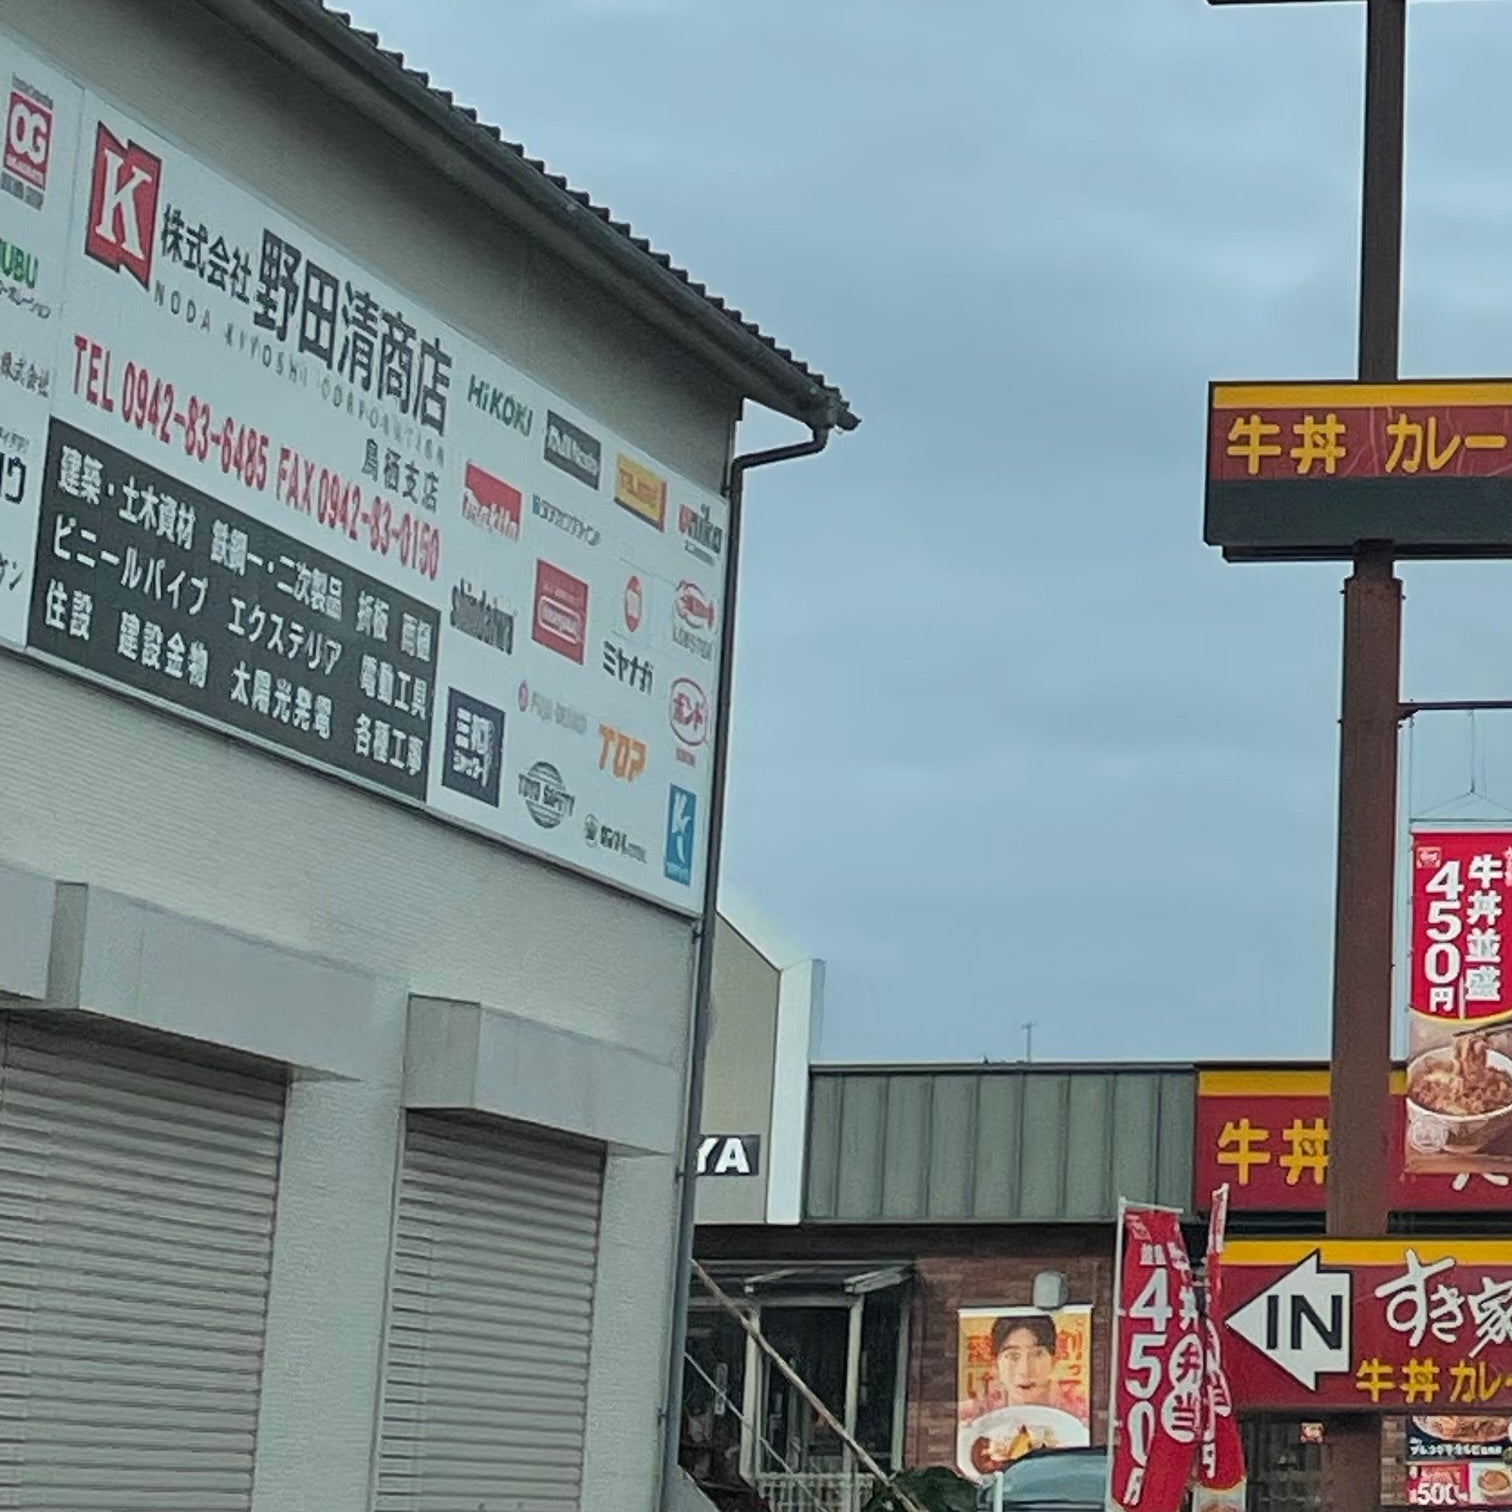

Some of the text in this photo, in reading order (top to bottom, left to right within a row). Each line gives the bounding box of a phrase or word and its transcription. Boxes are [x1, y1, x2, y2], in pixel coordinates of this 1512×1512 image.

[154, 279, 212, 333] NODA
[73, 334, 114, 413] TEL
[121, 360, 270, 492] 0942-83-6485
[275, 446, 316, 514] FAX
[1227, 412, 1508, 475] 牛丼 カレー
[53, 513, 209, 616] ビニールパイプ
[227, 596, 343, 676] エクステリア
[45, 578, 94, 641] 住設
[117, 610, 209, 689] 建設金物
[230, 660, 333, 740] 太陽光発電
[598, 723, 647, 784] TOP
[1424, 859, 1465, 1013] 450円
[1465, 853, 1503, 1003] 牛丼並盛
[1216, 1117, 1329, 1186] 牛丼
[1266, 1294, 1343, 1351] IN
[1355, 1357, 1441, 1404] 牛丼
